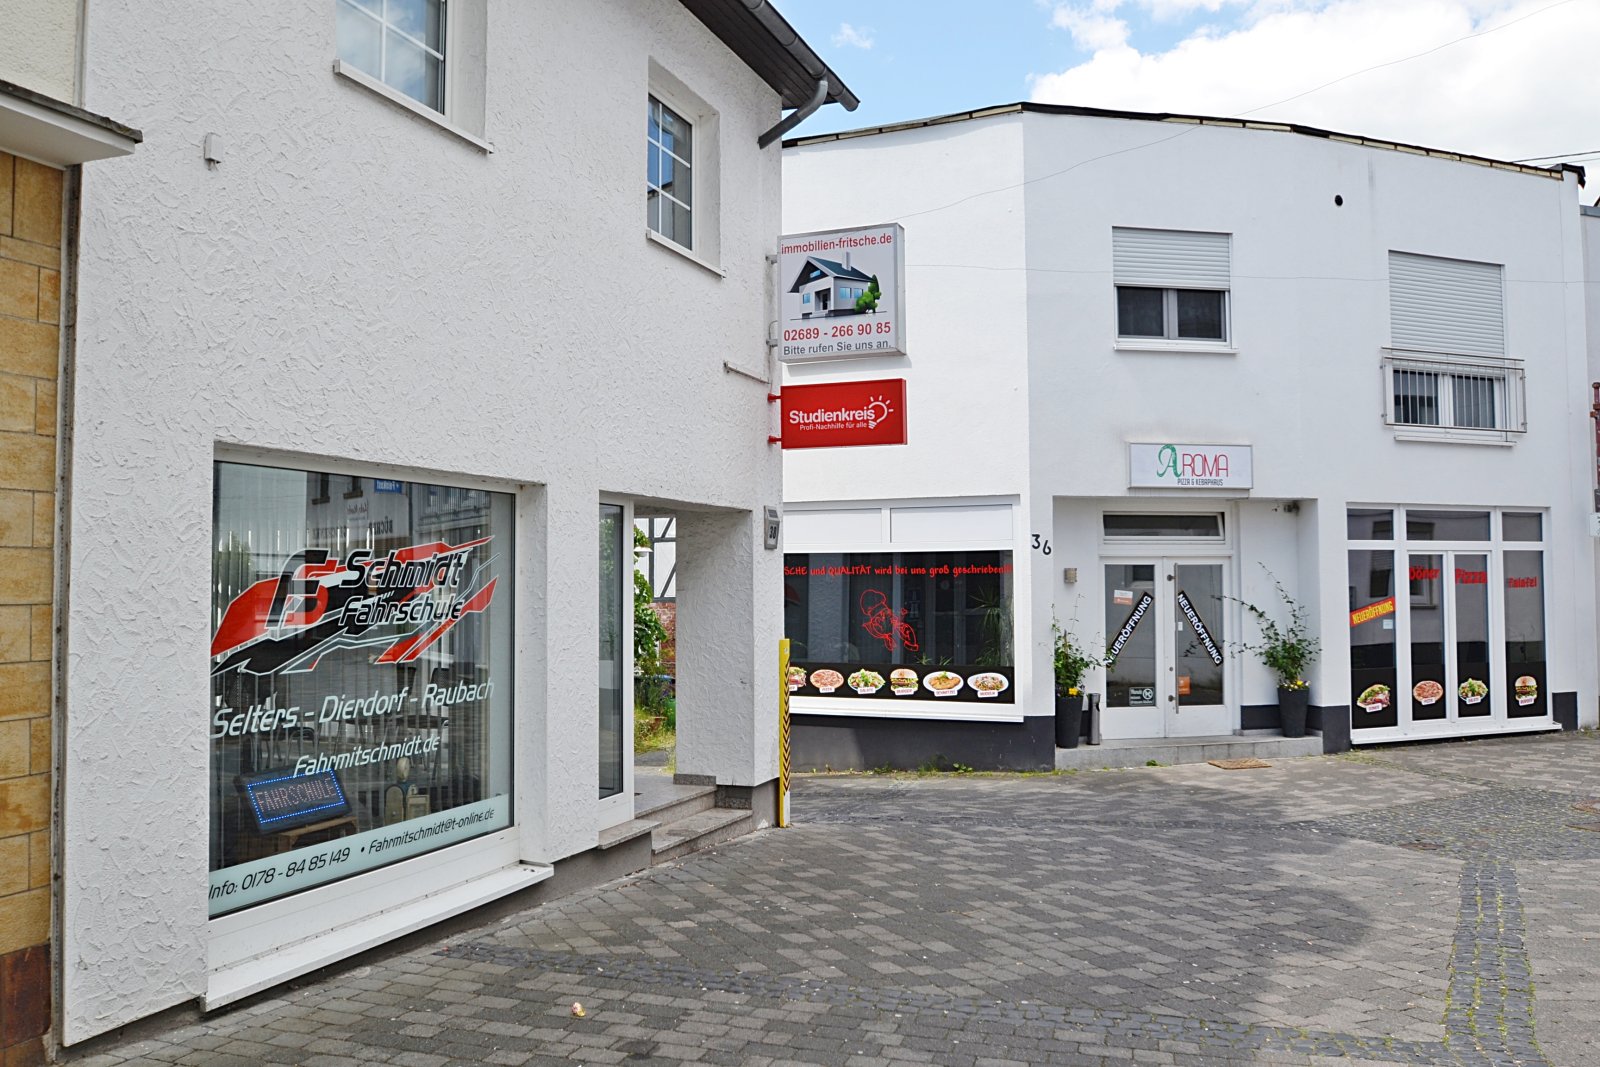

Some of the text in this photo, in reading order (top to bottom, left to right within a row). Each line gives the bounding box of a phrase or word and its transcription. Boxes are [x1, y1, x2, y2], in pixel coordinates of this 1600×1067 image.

[781, 233, 892, 254] immobilien-fritsche.de
[784, 327, 820, 341] 02689
[831, 324, 853, 338] 266
[857, 323, 872, 336] 90
[876, 321, 891, 334] 85
[783, 345, 806, 356] Bitte
[808, 343, 834, 353] rufen
[836, 341, 852, 352] Sie
[855, 341, 873, 350] uns
[789, 406, 876, 424] Studienkreis
[800, 421, 844, 431] Profi-Nachhilfe
[846, 421, 855, 429] für
[1157, 444, 1229, 477] AROMA
[1177, 478, 1190, 486] PIZZA
[769, 525, 777, 539] 38
[1031, 533, 1051, 556] 36
[339, 547, 472, 588] Schmidt
[810, 566, 826, 576] und
[827, 564, 872, 576] QUALITÄT
[874, 565, 892, 575] wird
[895, 564, 908, 575] bei
[911, 566, 926, 575] uns
[929, 564, 949, 578] groß
[338, 592, 465, 626] Fahrschule
[1177, 593, 1222, 665] NEUERÖFFNUNG
[210, 704, 300, 739] Selters
[319, 687, 409, 723] Dierdorf
[421, 677, 495, 708] Raubach
[293, 733, 441, 778] Fahrmitschmidt.de
[255, 777, 337, 812] FAHRSCHULE
[368, 807, 496, 855] Fahrmitschmidt@t-online.de
[208, 880, 238, 900] Info:
[241, 867, 276, 890] 0178
[285, 859, 306, 877] 84
[308, 852, 328, 872] 85
[328, 847, 351, 866] 149
